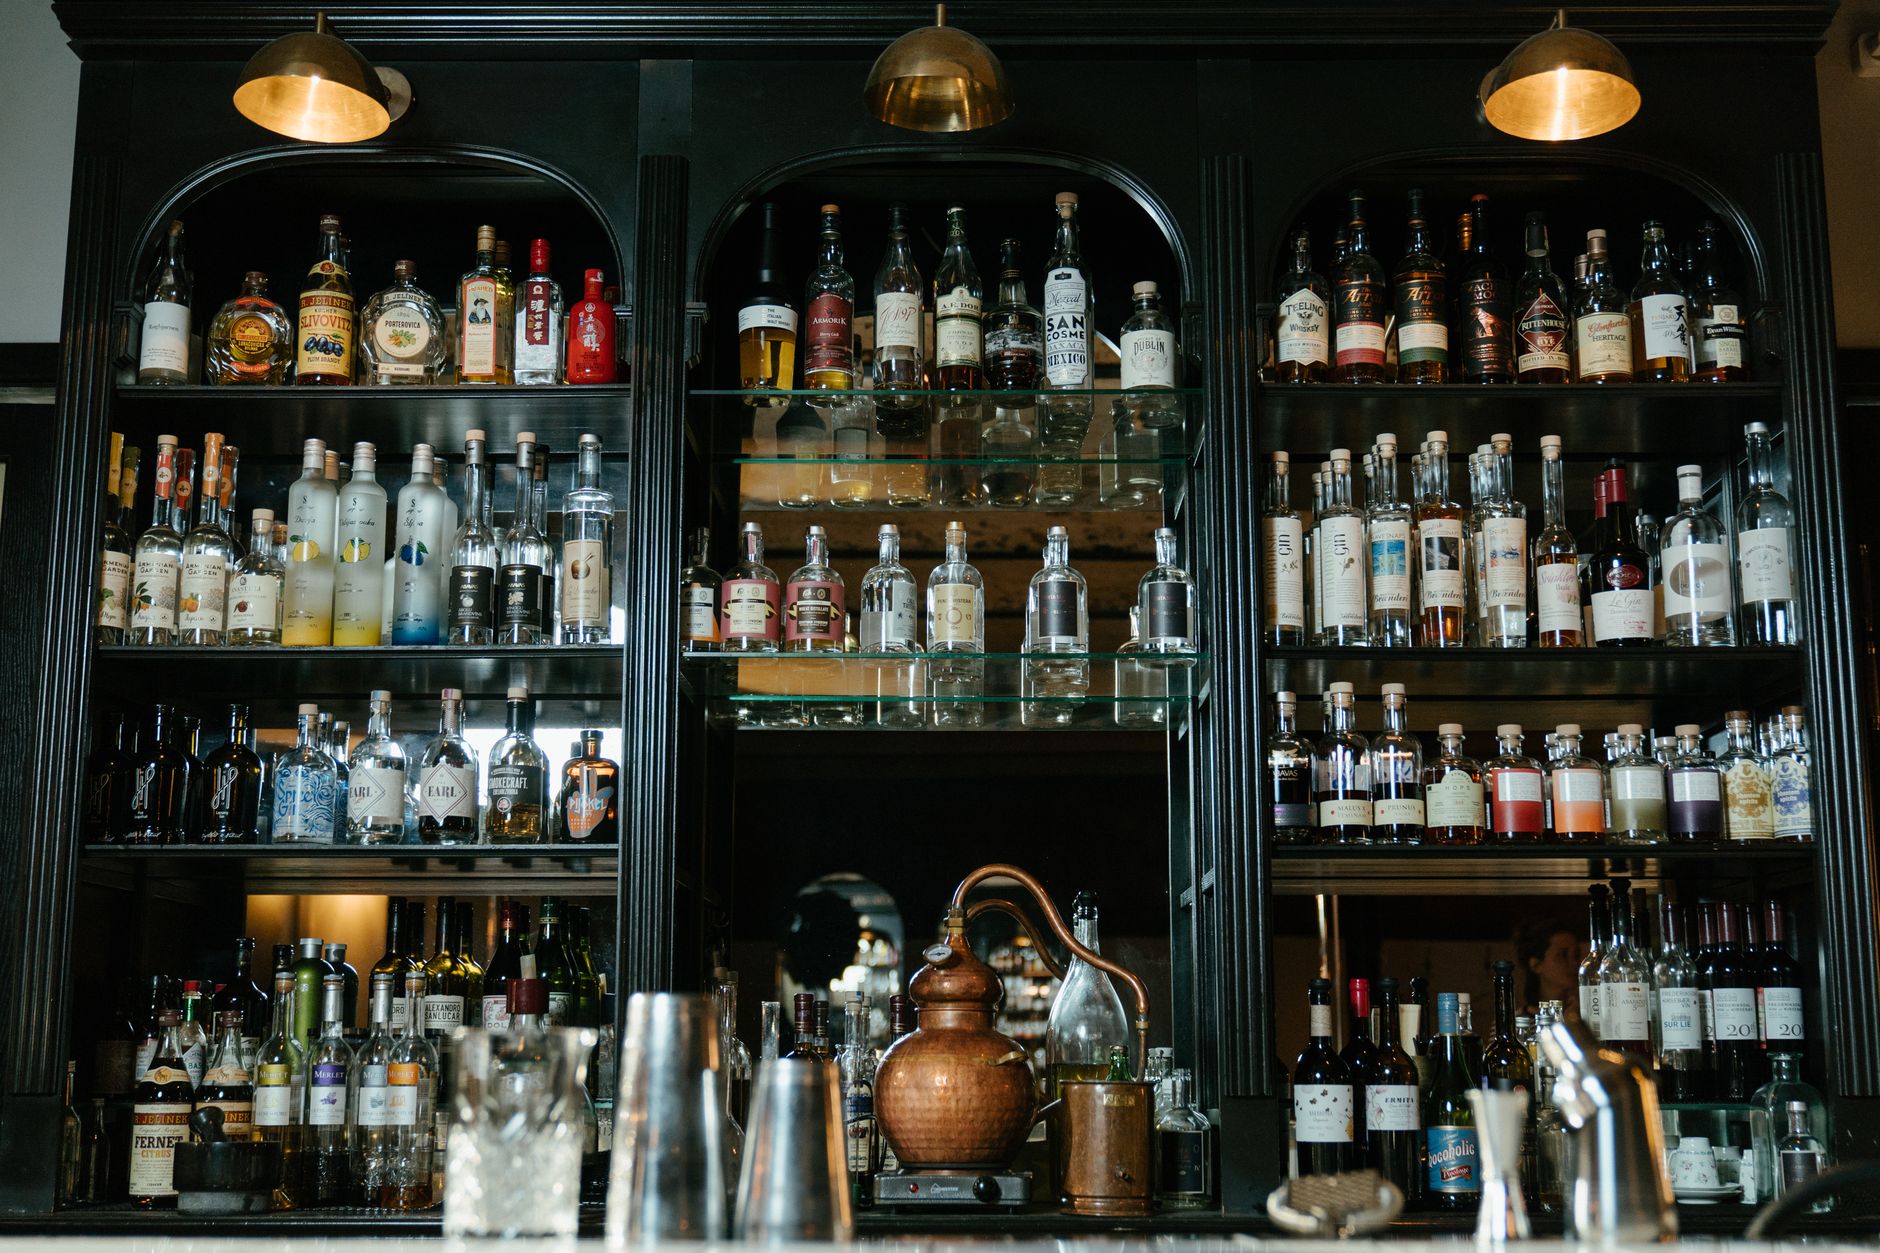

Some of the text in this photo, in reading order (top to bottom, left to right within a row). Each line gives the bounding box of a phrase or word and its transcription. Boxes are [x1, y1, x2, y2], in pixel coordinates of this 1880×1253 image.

[1285, 302, 1324, 317] TEELING
[301, 314, 351, 331] SLIVOVITZ
[385, 320, 421, 328] PORTEROVICA
[812, 317, 847, 325] ARMORIK
[1047, 315, 1085, 332] SAN
[1289, 323, 1319, 333] WHISKEY
[1047, 331, 1085, 342] COSME
[1592, 333, 1627, 342] HERITAGE
[1134, 341, 1165, 356] DUBLIN
[1047, 353, 1086, 367] MEXICO
[428, 786, 457, 798] EARL
[424, 1002, 461, 1012] ALEXANDRO
[424, 1011, 460, 1021] SANLUCAR
[1681, 1020, 1692, 1028] LIE
[314, 1070, 345, 1079] MERLET
[141, 1149, 171, 1158] CITRUS
[1428, 1141, 1475, 1168] hocoholic
